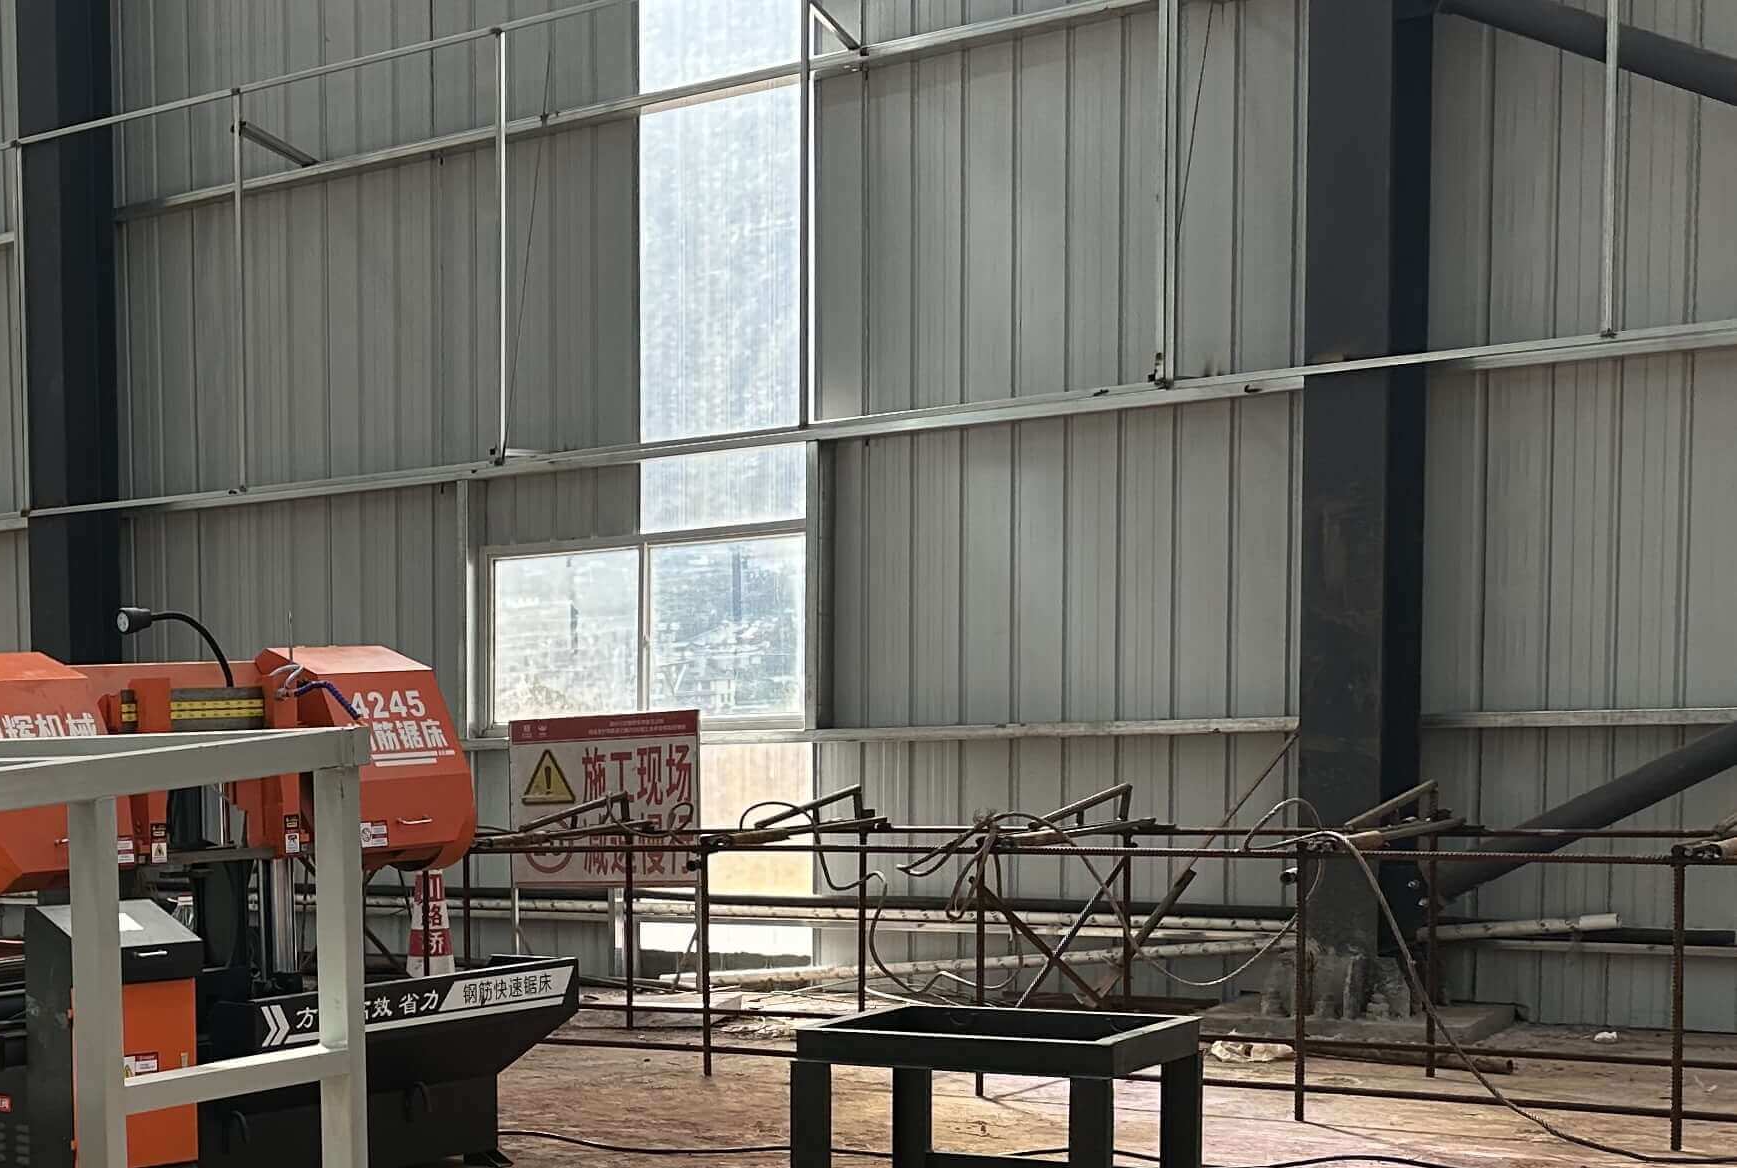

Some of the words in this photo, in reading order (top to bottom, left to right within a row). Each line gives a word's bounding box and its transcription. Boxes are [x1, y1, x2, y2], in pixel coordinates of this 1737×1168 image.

[352, 690, 426, 719] 4245
[369, 719, 449, 751] 筋锯床
[582, 744, 692, 805] 施工现场
[399, 989, 439, 1015] 省力
[463, 974, 553, 1005] 钢筋快速锯床
